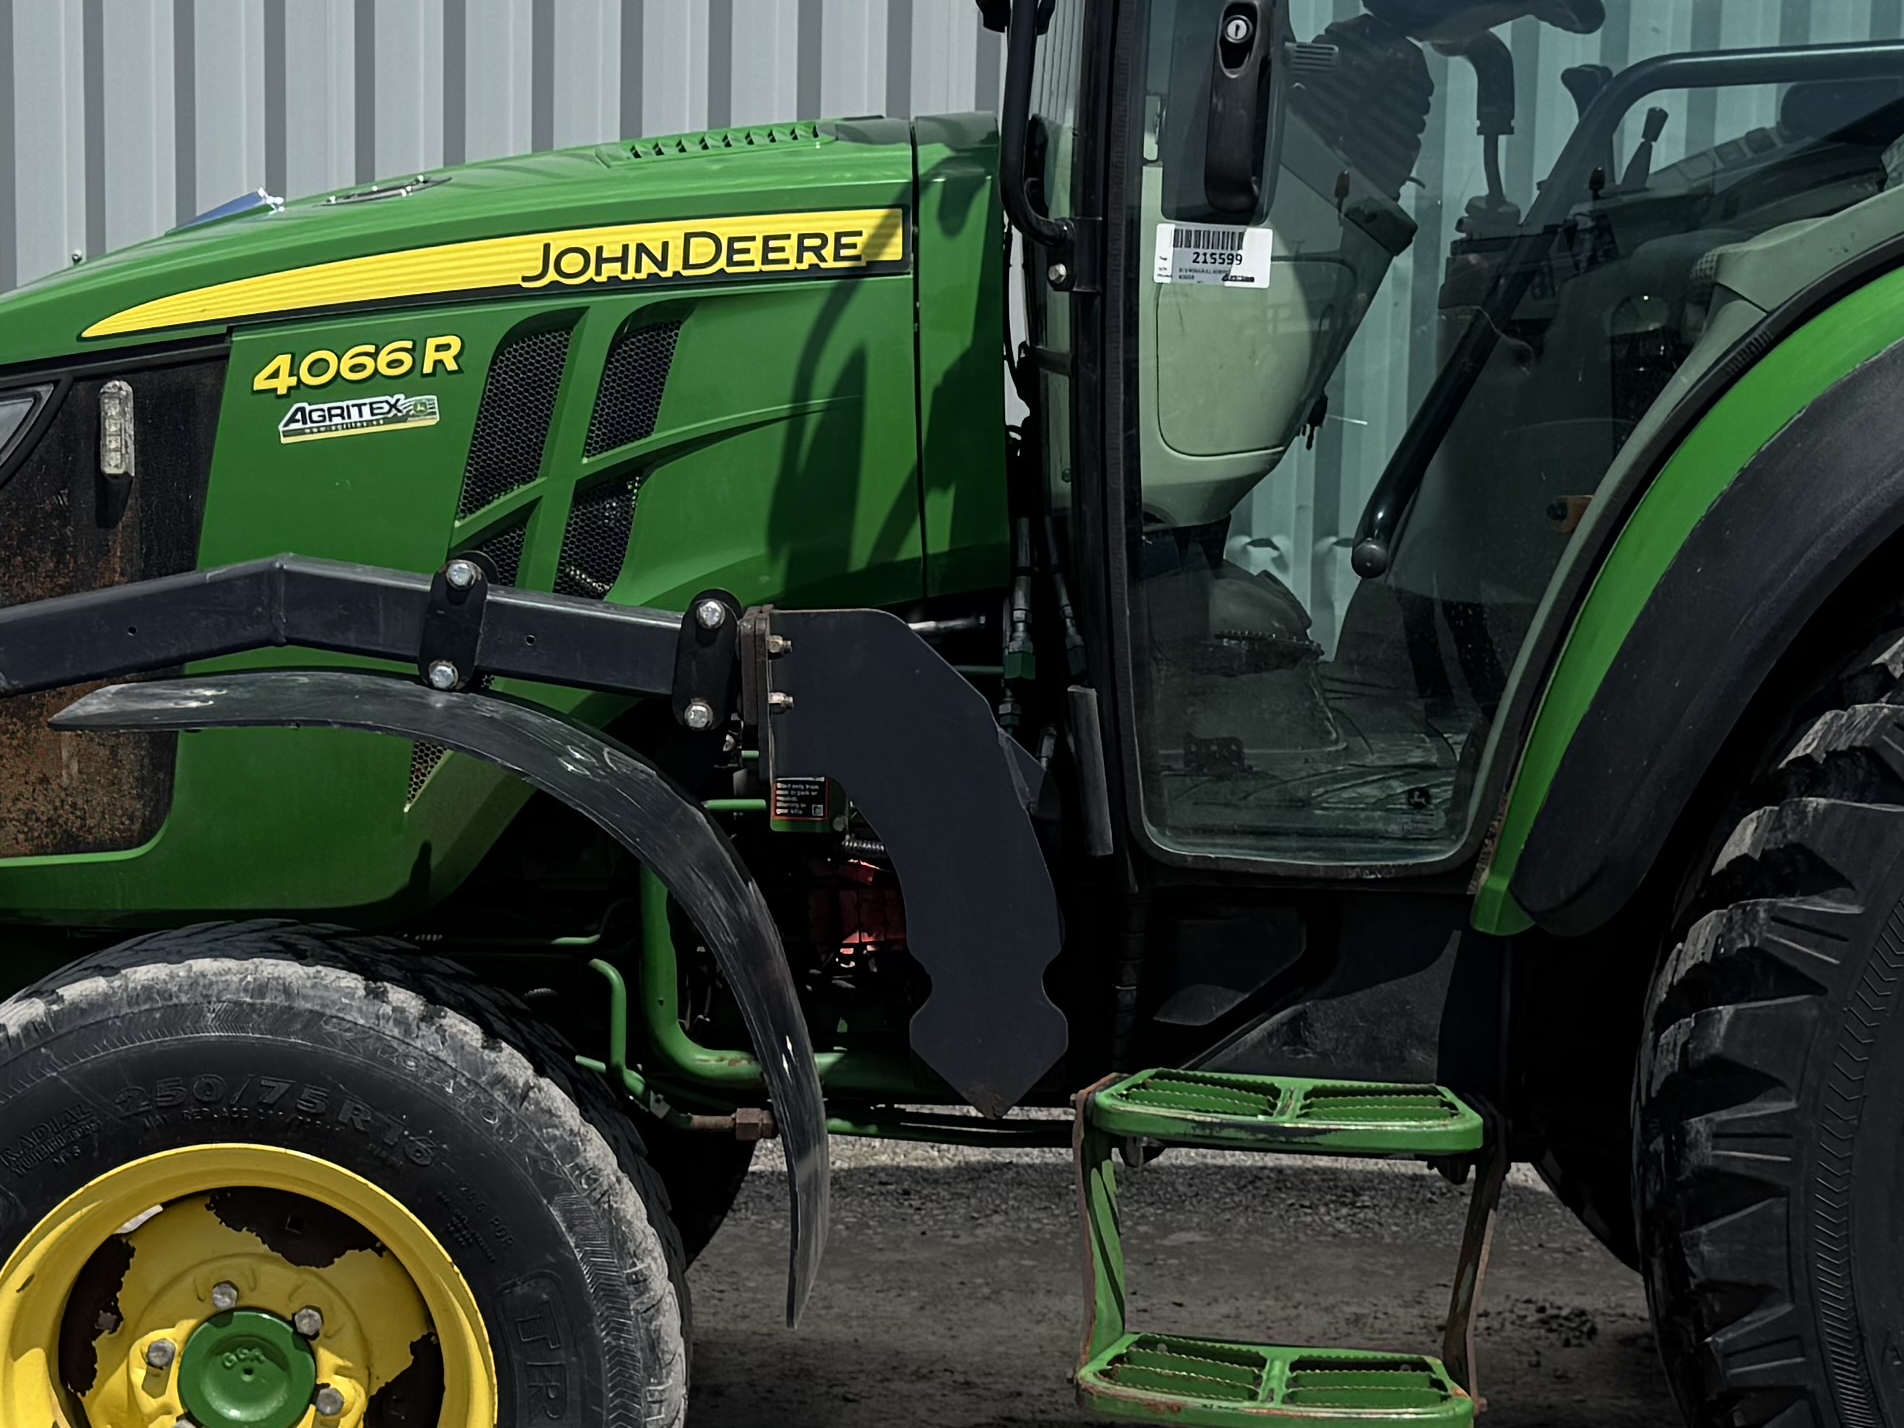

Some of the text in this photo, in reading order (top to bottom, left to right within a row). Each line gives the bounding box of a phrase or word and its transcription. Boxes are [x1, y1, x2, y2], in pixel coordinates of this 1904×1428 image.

[521, 229, 864, 283] JOHN DEERE
[1192, 251, 1243, 265] 215599
[283, 397, 404, 428] AGRITEX
